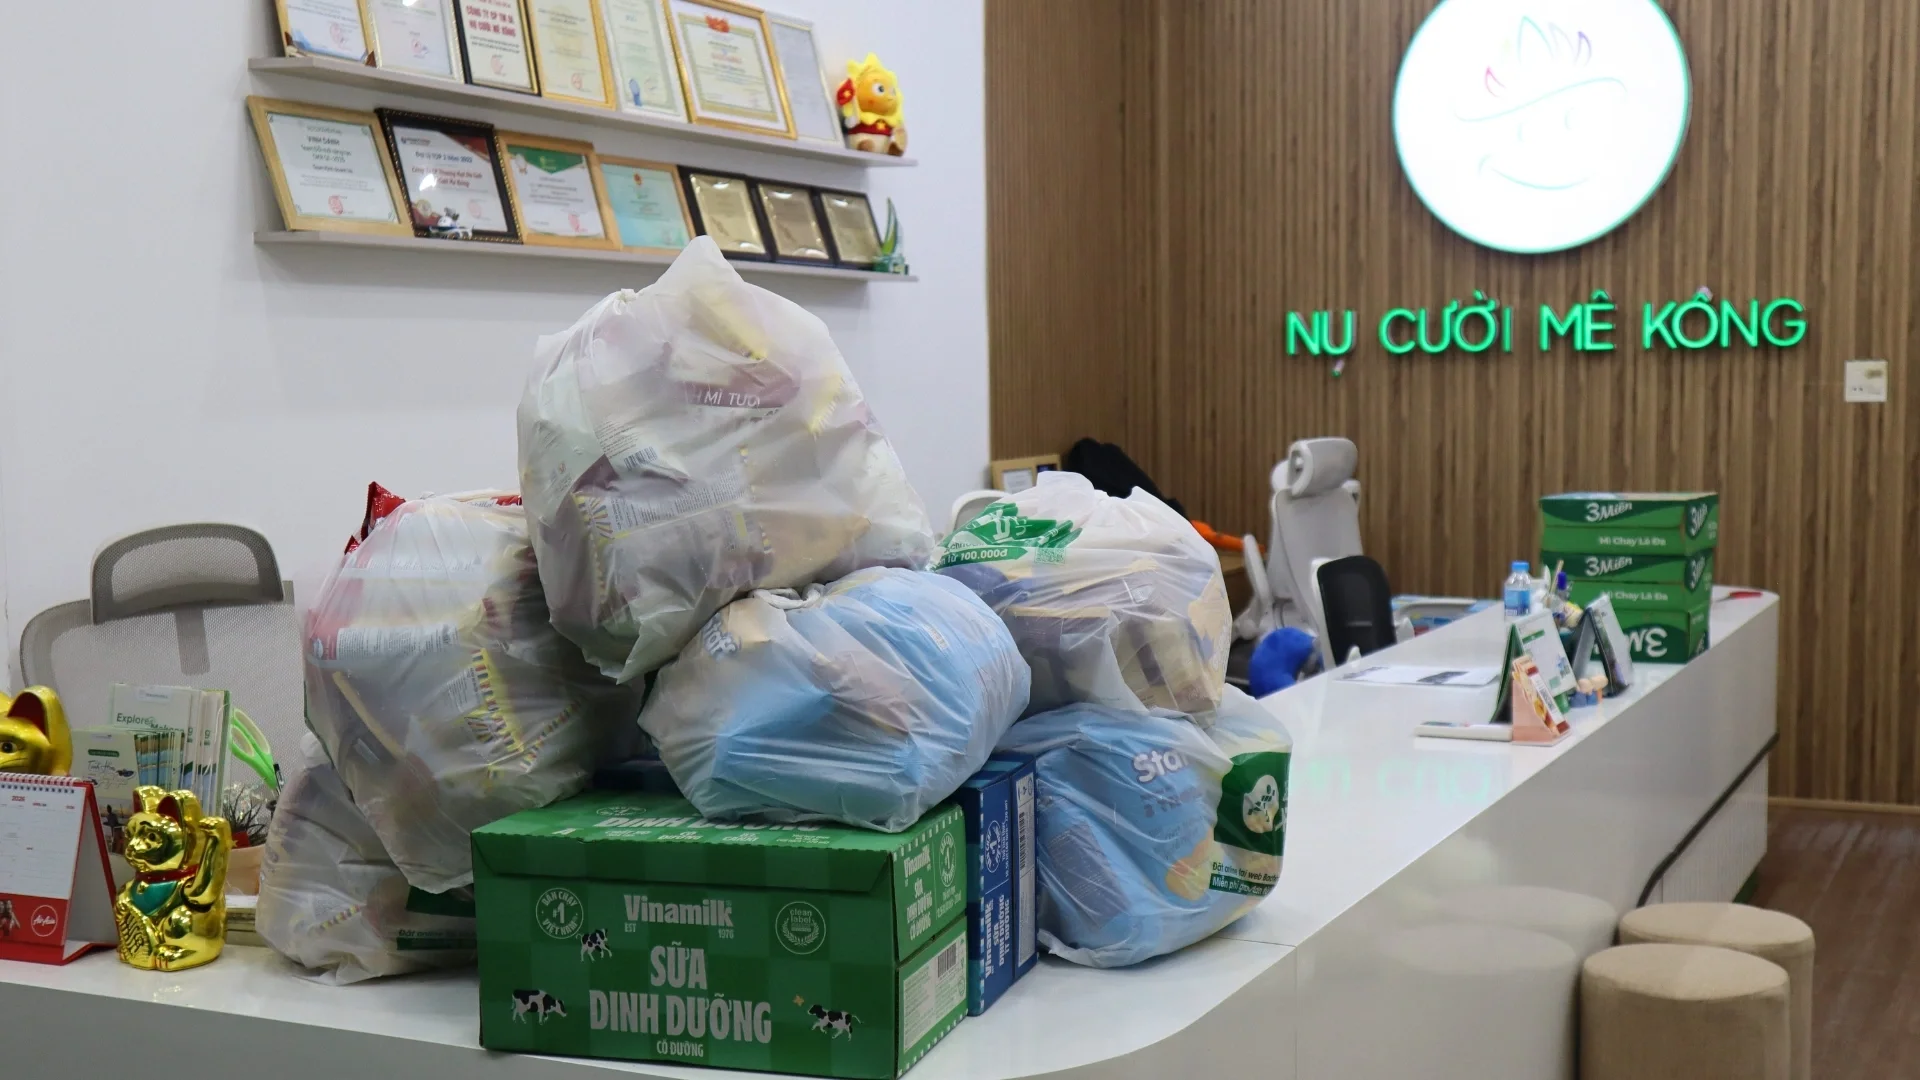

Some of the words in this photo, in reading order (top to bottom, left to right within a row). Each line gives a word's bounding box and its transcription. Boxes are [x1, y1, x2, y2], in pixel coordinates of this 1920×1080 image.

[1286, 310, 1356, 377] NỤ
[1378, 289, 1514, 355] CƯỜI
[1539, 289, 1616, 352] MÊ
[1641, 286, 1808, 350] KÔNG
[623, 894, 734, 927] Vinamilk
[789, 908, 813, 917] clean
[790, 916, 811, 924] label
[624, 922, 637, 933] EST
[718, 928, 734, 939] 1976
[650, 940, 708, 990] SỮA
[589, 989, 659, 1035] DINH
[666, 992, 772, 1044] DƯỠNG
[656, 1038, 669, 1055] CÓ
[669, 1039, 704, 1058] ĐƯỜNG
